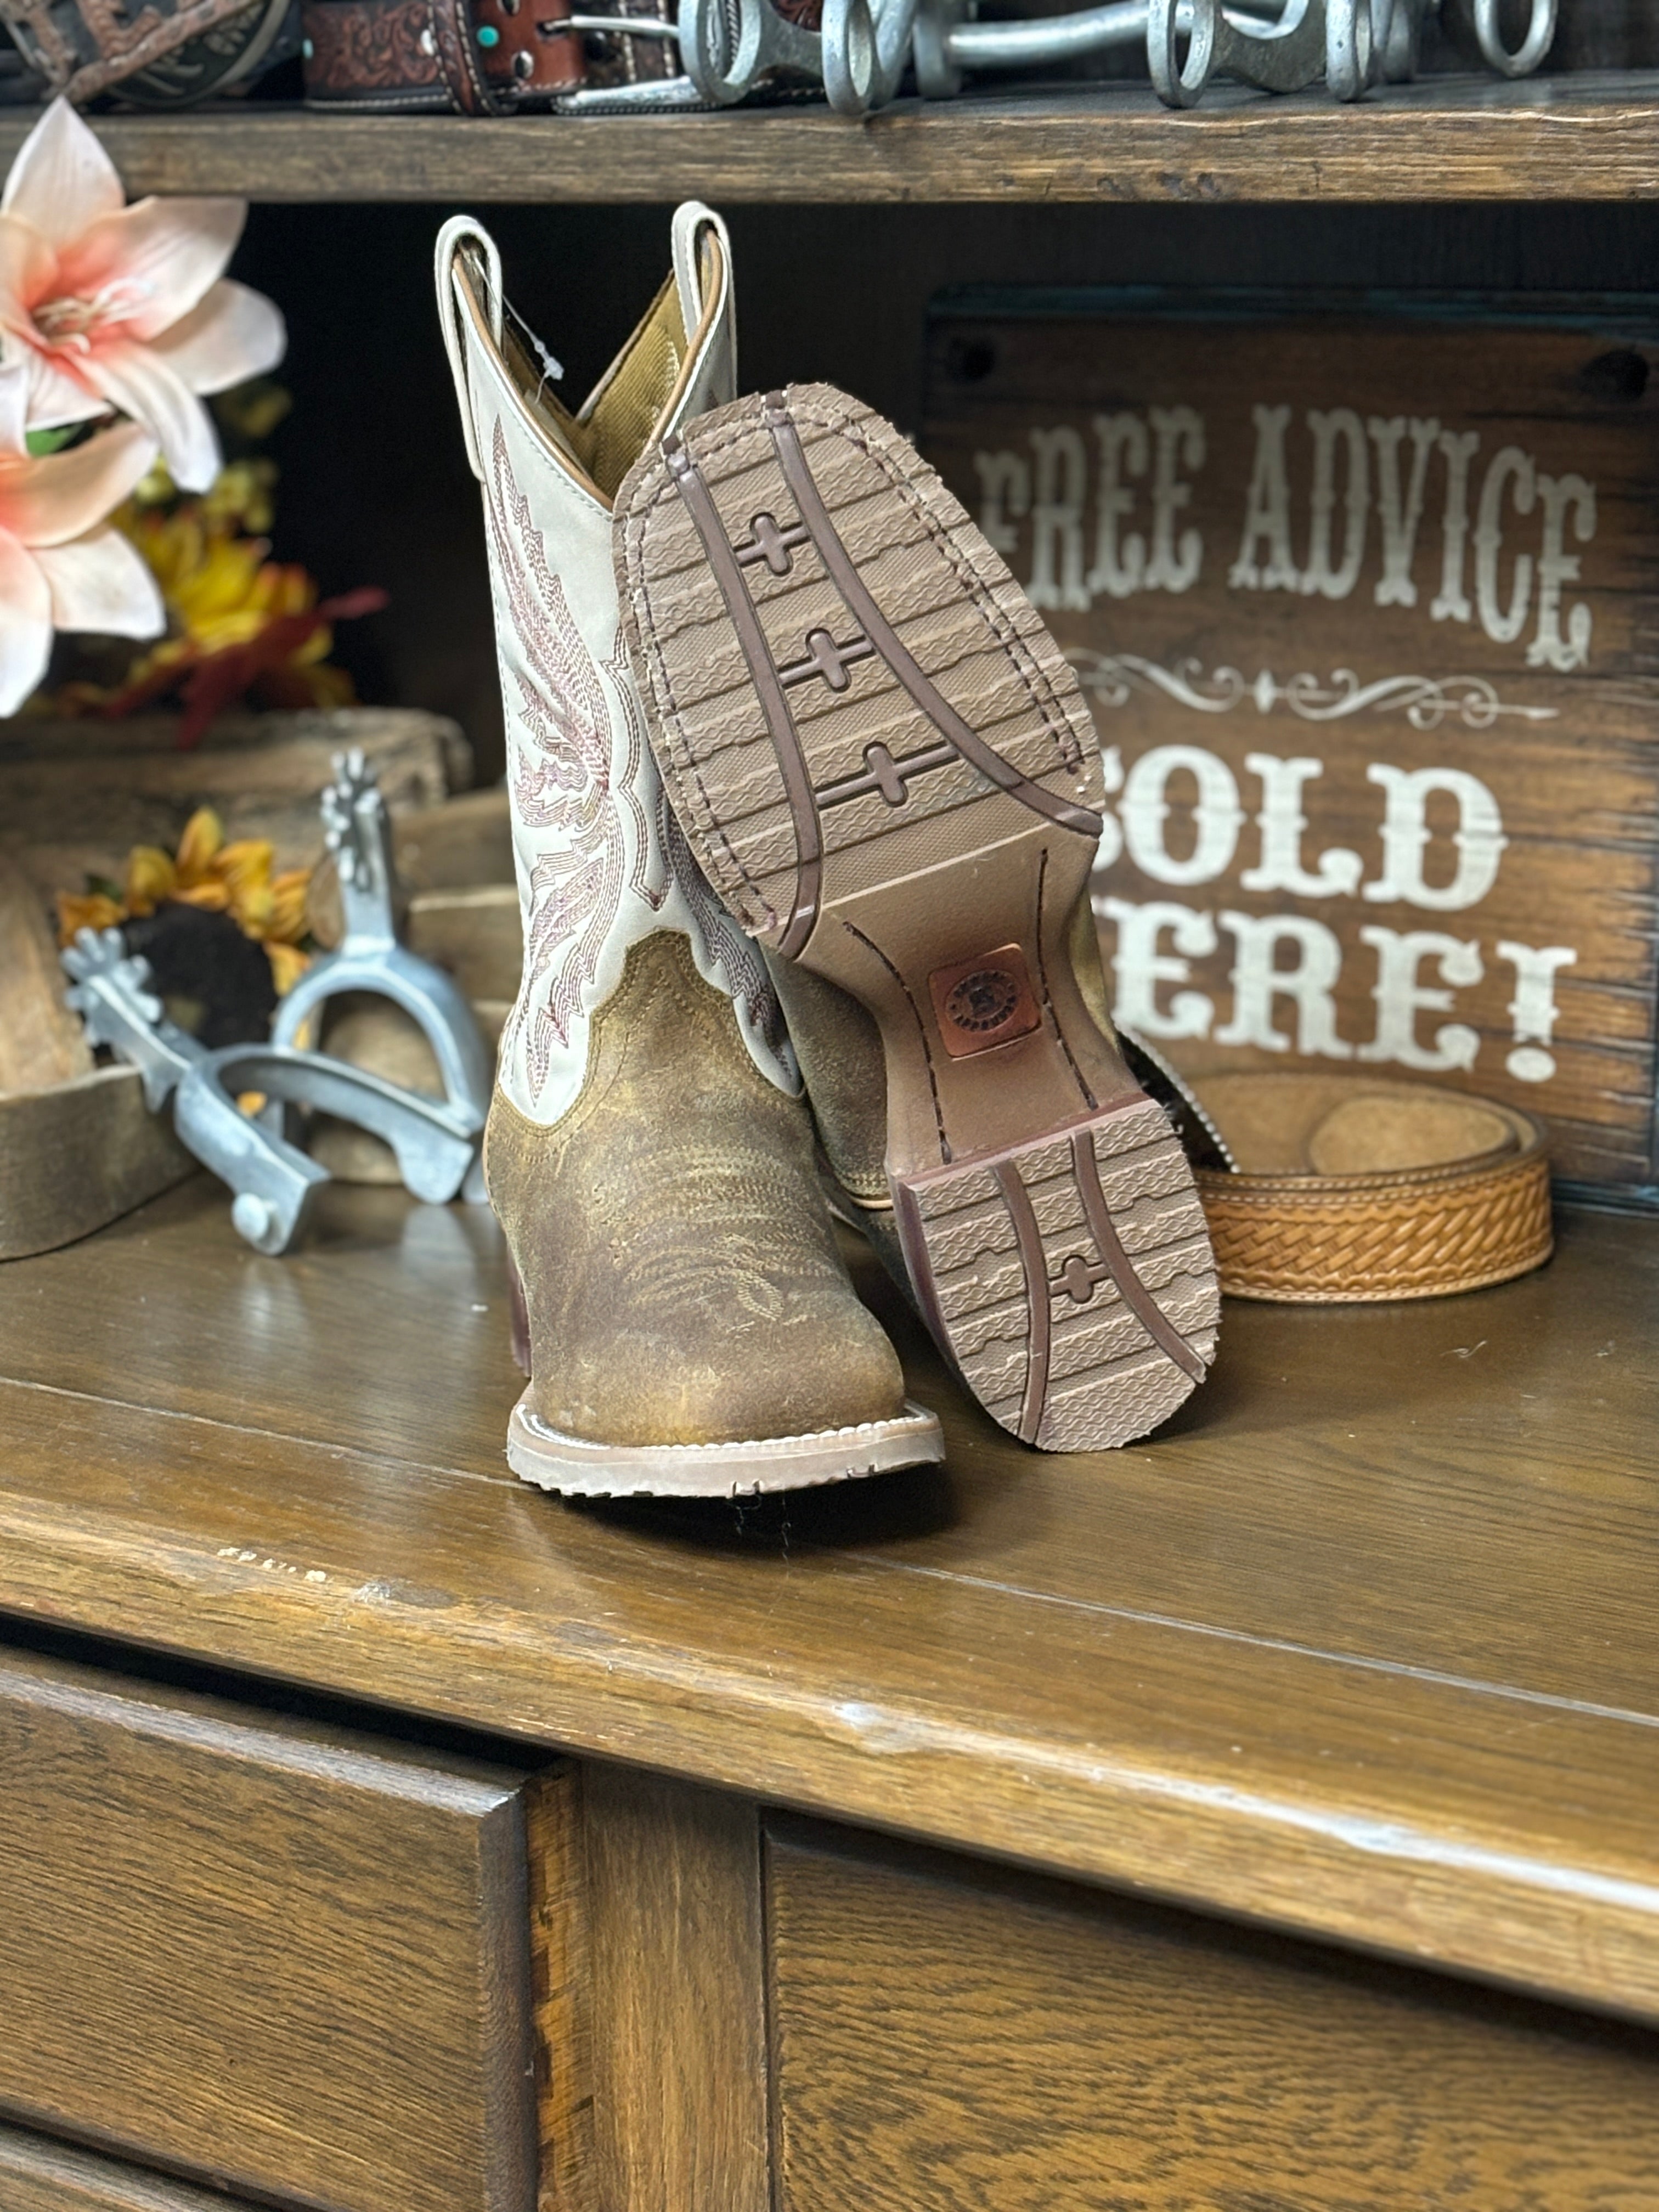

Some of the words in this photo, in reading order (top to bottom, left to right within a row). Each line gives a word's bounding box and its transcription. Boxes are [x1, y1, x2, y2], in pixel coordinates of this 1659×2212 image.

[973, 405, 1205, 613] FREE
[1228, 404, 1597, 672] ADVICE
[1093, 744, 1509, 912] OLD
[1092, 895, 1577, 1083] ERE!
